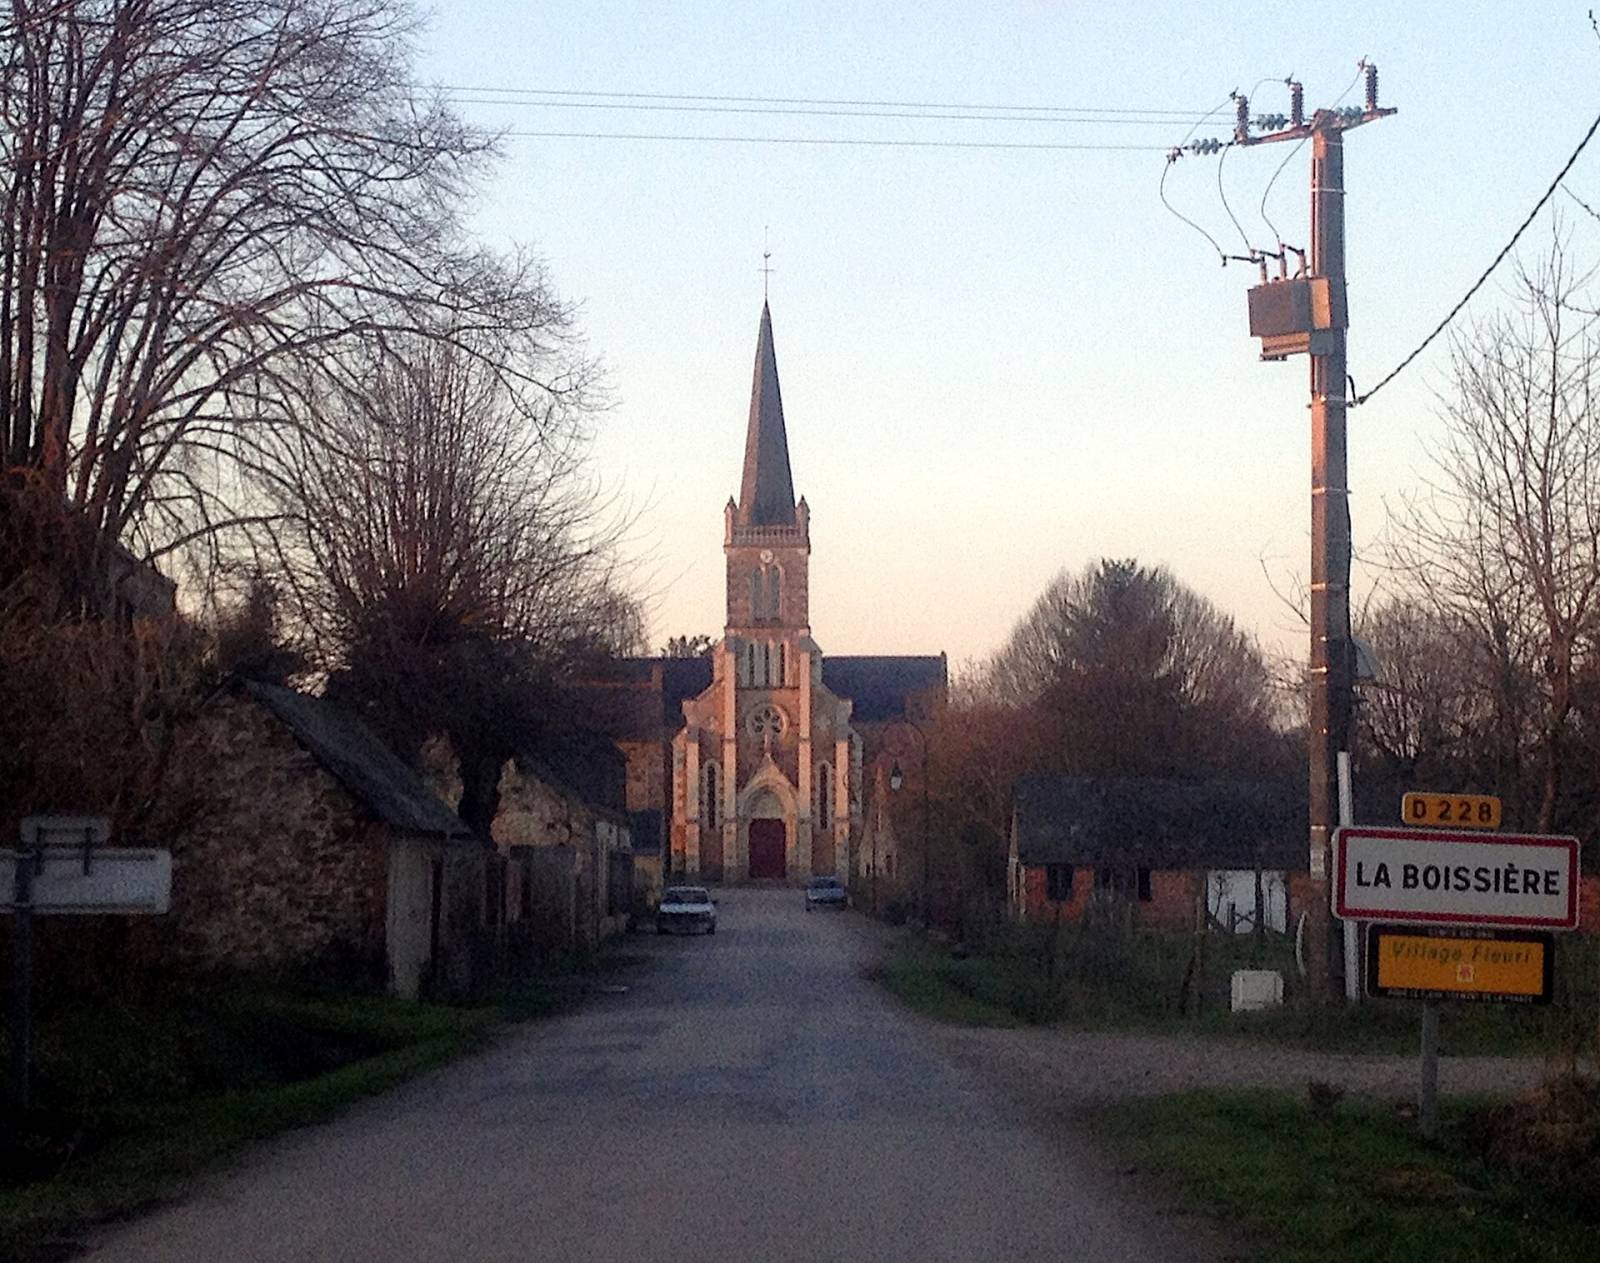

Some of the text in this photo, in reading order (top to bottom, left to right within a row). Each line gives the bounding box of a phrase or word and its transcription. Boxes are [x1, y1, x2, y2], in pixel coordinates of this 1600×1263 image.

[1412, 801, 1492, 822] D 228
[1356, 862, 1561, 896] LA BOISSIÈRE
[1392, 941, 1462, 964] Village
